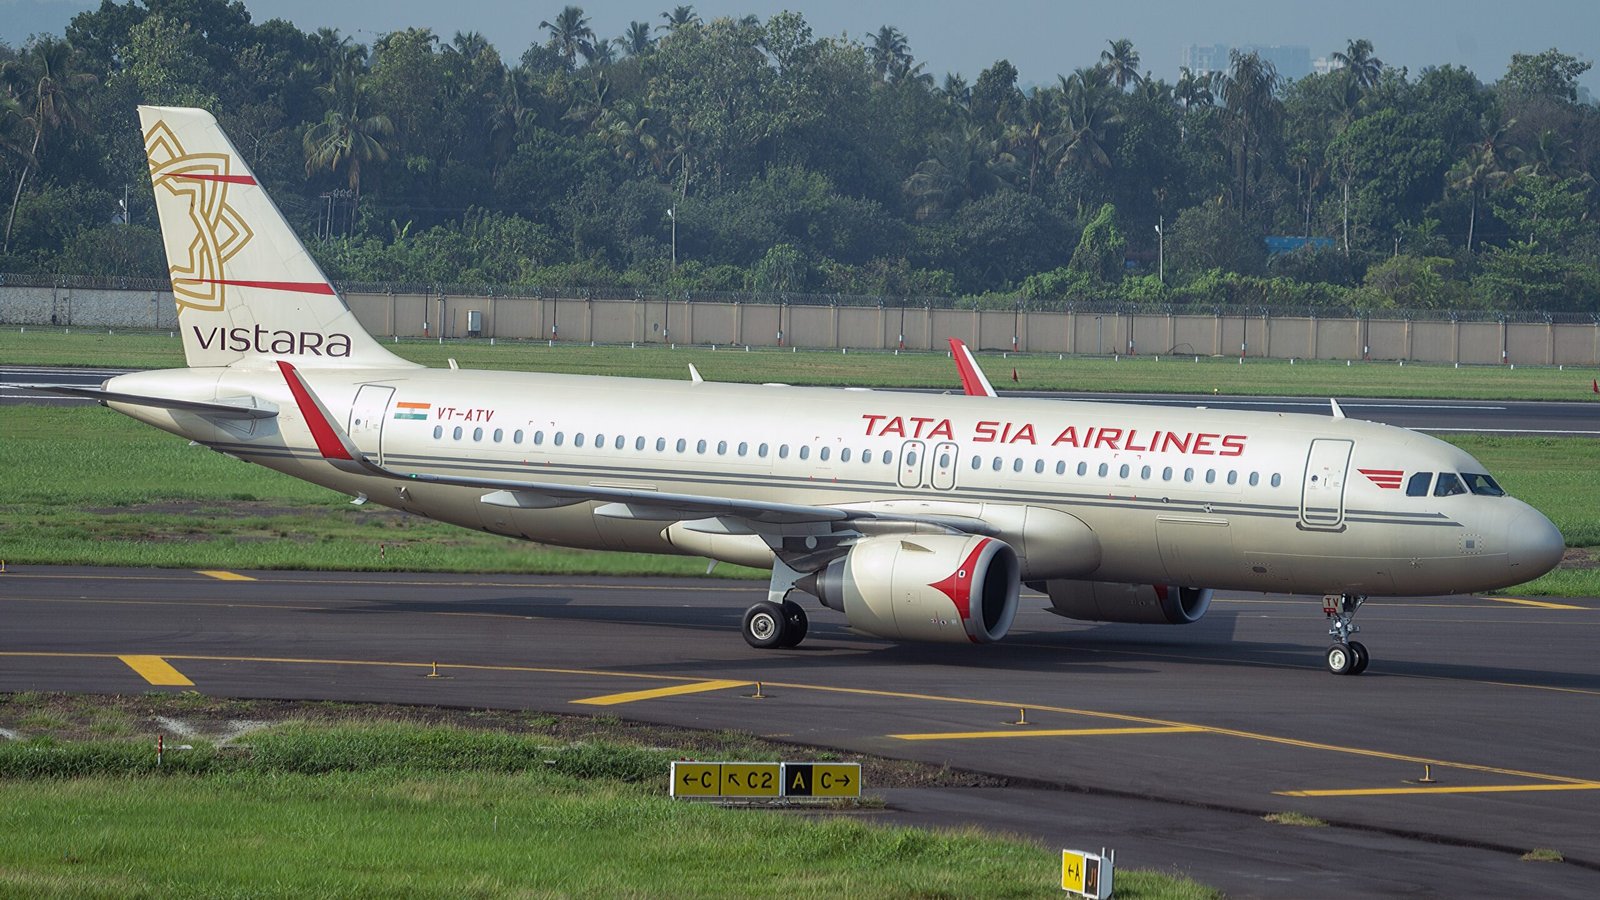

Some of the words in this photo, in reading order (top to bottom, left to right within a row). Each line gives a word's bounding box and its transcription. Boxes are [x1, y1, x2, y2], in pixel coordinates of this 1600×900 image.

[437, 407, 495, 423] VT-ATV
[862, 414, 955, 441] TATA
[973, 421, 1037, 445] SIA
[1052, 426, 1247, 457] AIRLINES
[1325, 598, 1338, 607] TV
[701, 771, 712, 788] C
[747, 771, 773, 788] C2
[792, 771, 805, 789] A
[821, 772, 832, 788] C
[1074, 863, 1081, 882] A
